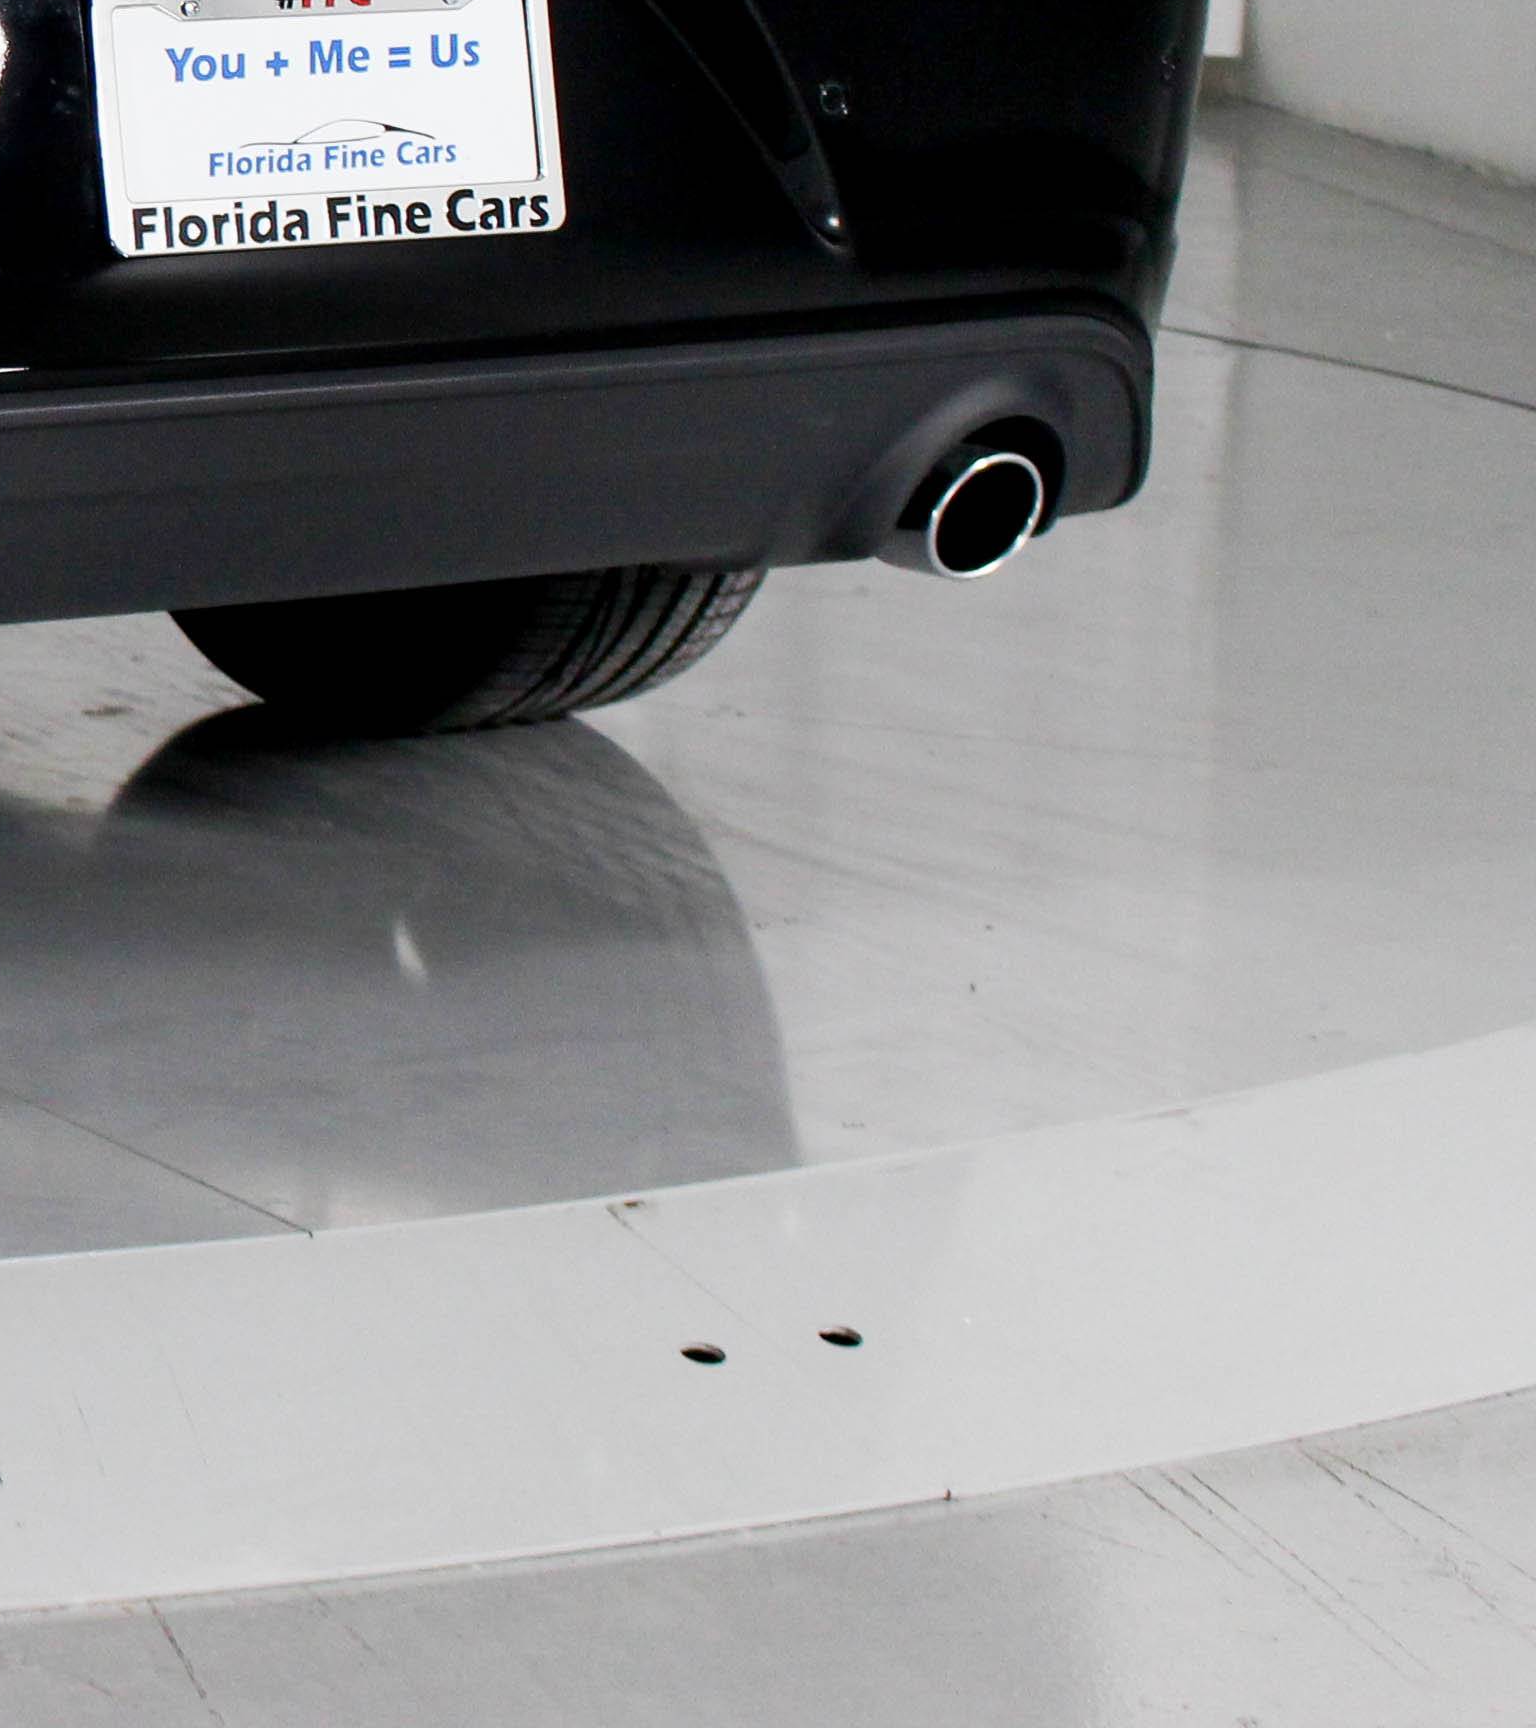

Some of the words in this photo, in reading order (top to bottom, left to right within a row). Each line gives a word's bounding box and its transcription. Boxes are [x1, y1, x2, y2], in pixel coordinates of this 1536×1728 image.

[165, 46, 246, 82] You
[308, 39, 370, 73] Me
[430, 34, 480, 68] Us
[208, 146, 312, 177] Florida
[324, 144, 386, 170] Fine
[396, 140, 457, 165] Cars
[131, 200, 310, 251] Florida
[328, 193, 432, 239] Fine
[446, 188, 550, 231] Cars
